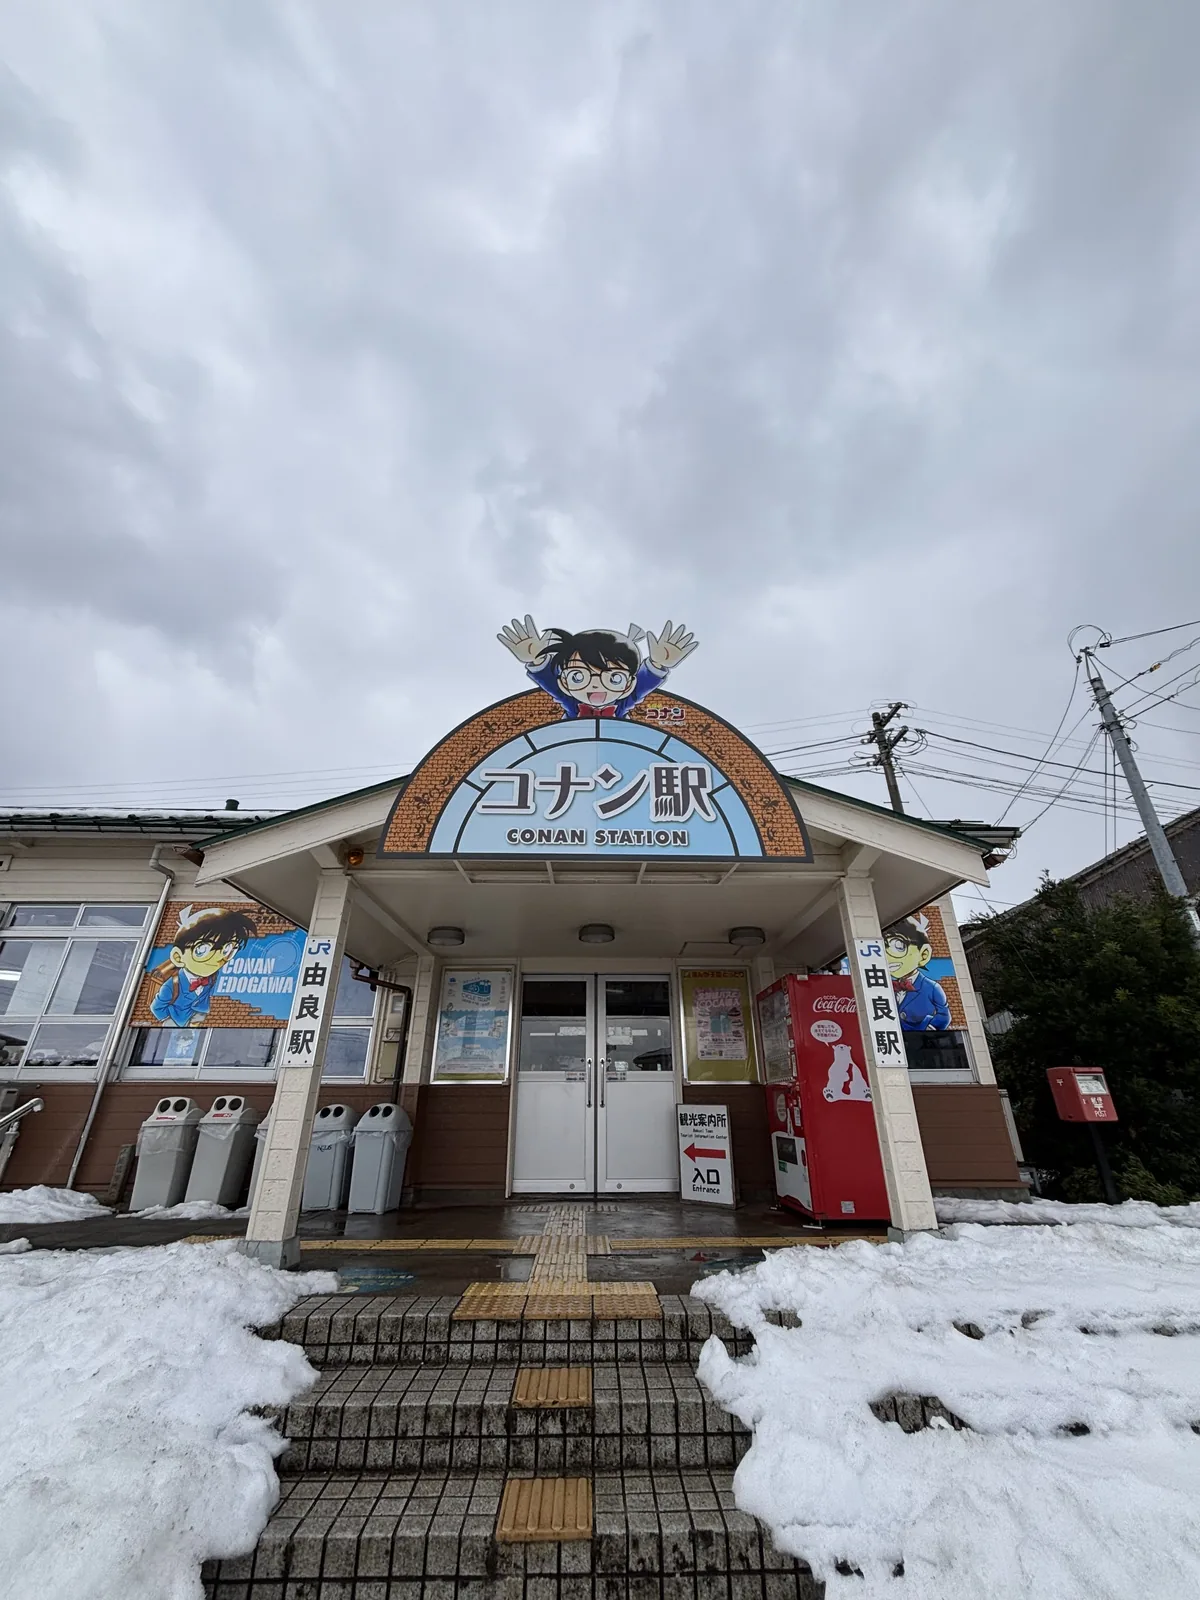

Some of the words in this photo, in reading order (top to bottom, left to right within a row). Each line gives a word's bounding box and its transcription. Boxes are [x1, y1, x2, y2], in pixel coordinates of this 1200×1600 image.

[645, 706, 686, 720] コナン
[480, 765, 716, 820] コナン駅
[506, 829, 586, 845] CONAN
[594, 829, 689, 846] STATION
[308, 942, 331, 955] JR
[860, 944, 882, 957] JR
[222, 957, 276, 975] CONAN
[216, 976, 294, 994] EDOGAWA
[287, 962, 328, 1055] 由良駅
[813, 996, 857, 1013] Coca-Cola
[864, 964, 902, 1056] 由良駅
[679, 1112, 727, 1127] 観光案内所
[692, 1168, 720, 1185] 入口
[692, 1184, 720, 1194] Entrance
